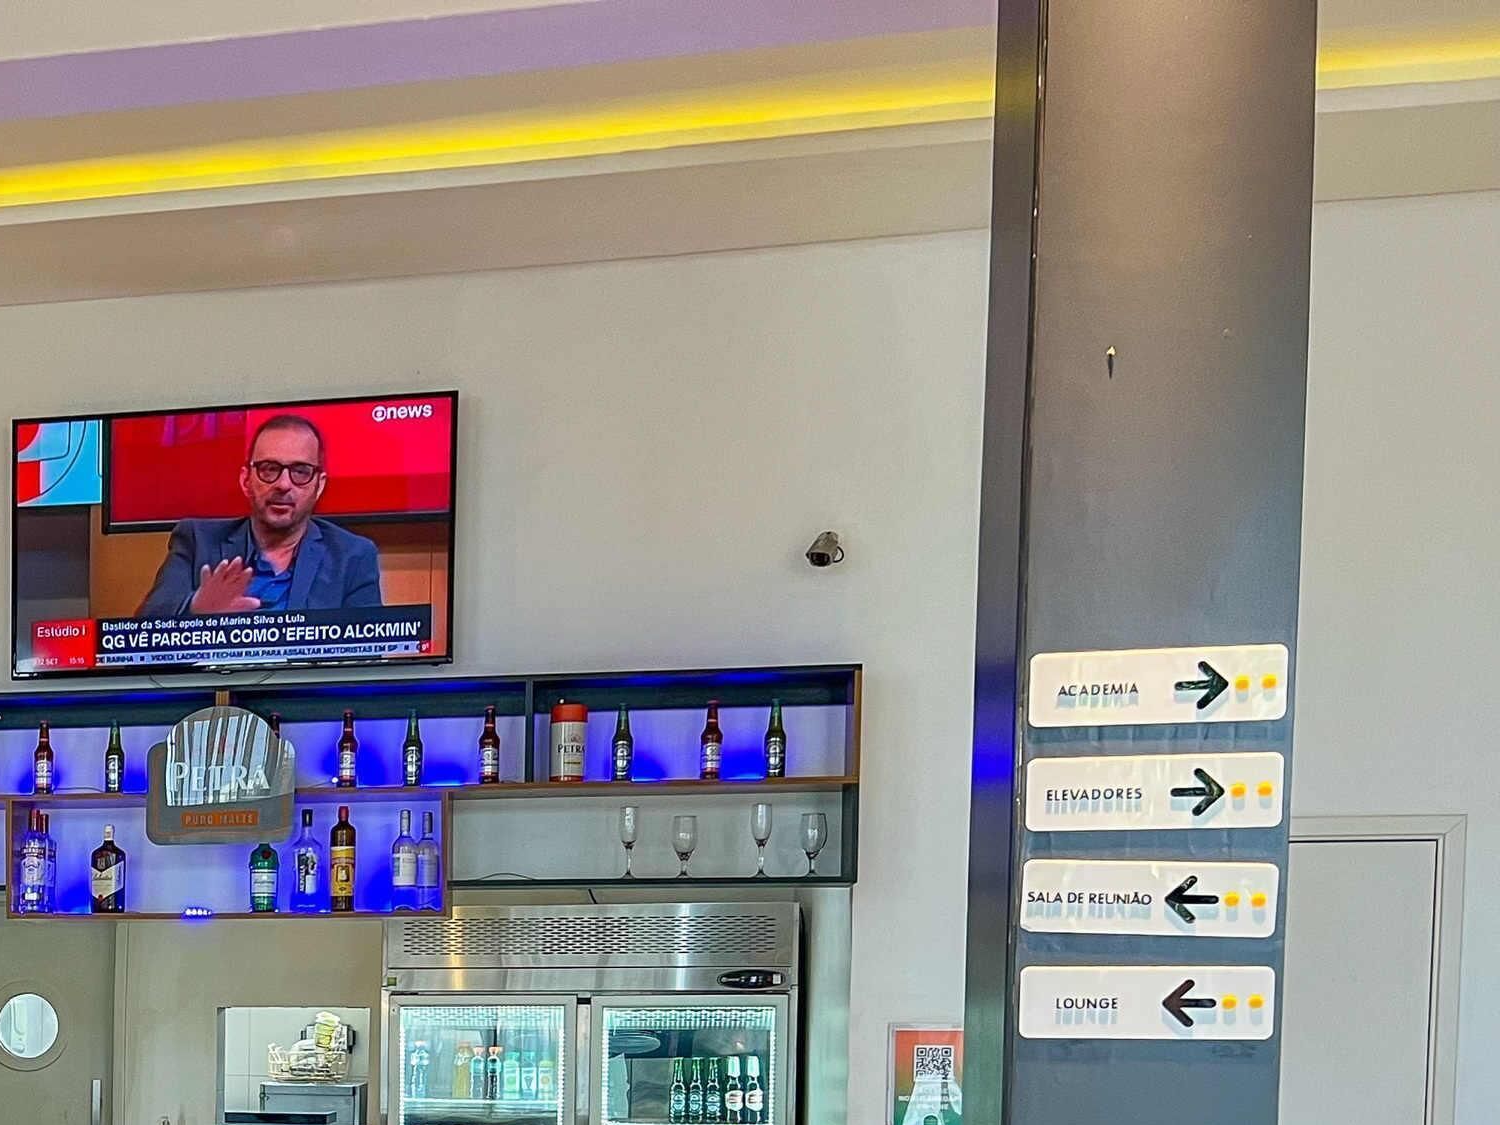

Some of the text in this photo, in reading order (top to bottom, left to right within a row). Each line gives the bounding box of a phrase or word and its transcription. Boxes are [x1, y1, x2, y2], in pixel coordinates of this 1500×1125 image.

[102, 621, 139, 632] Bastidor
[141, 620, 153, 630] da
[206, 617, 218, 627] de
[220, 616, 251, 627] Marina
[253, 614, 275, 625] Silva
[285, 613, 306, 624] Lula
[36, 625, 80, 638] Estúdio
[102, 621, 422, 650] QG VÊ PARCERIA COMO 'EFEITO ALCKMIN'
[212, 650, 243, 659] FECHAM
[244, 649, 260, 657] RUA
[261, 648, 281, 657] PARA
[283, 647, 322, 656] ASSALTAR
[323, 645, 373, 655] MOTORISTAS
[374, 645, 386, 653] EM
[1057, 682, 1139, 697] ACADEMIA
[172, 760, 271, 793] PETRA
[1045, 787, 1143, 802] ELEVADORES
[184, 811, 254, 826] PURO MALTE
[1027, 889, 1153, 906] SALA DE REUNIÃO
[1055, 997, 1119, 1011] LOUNGE
